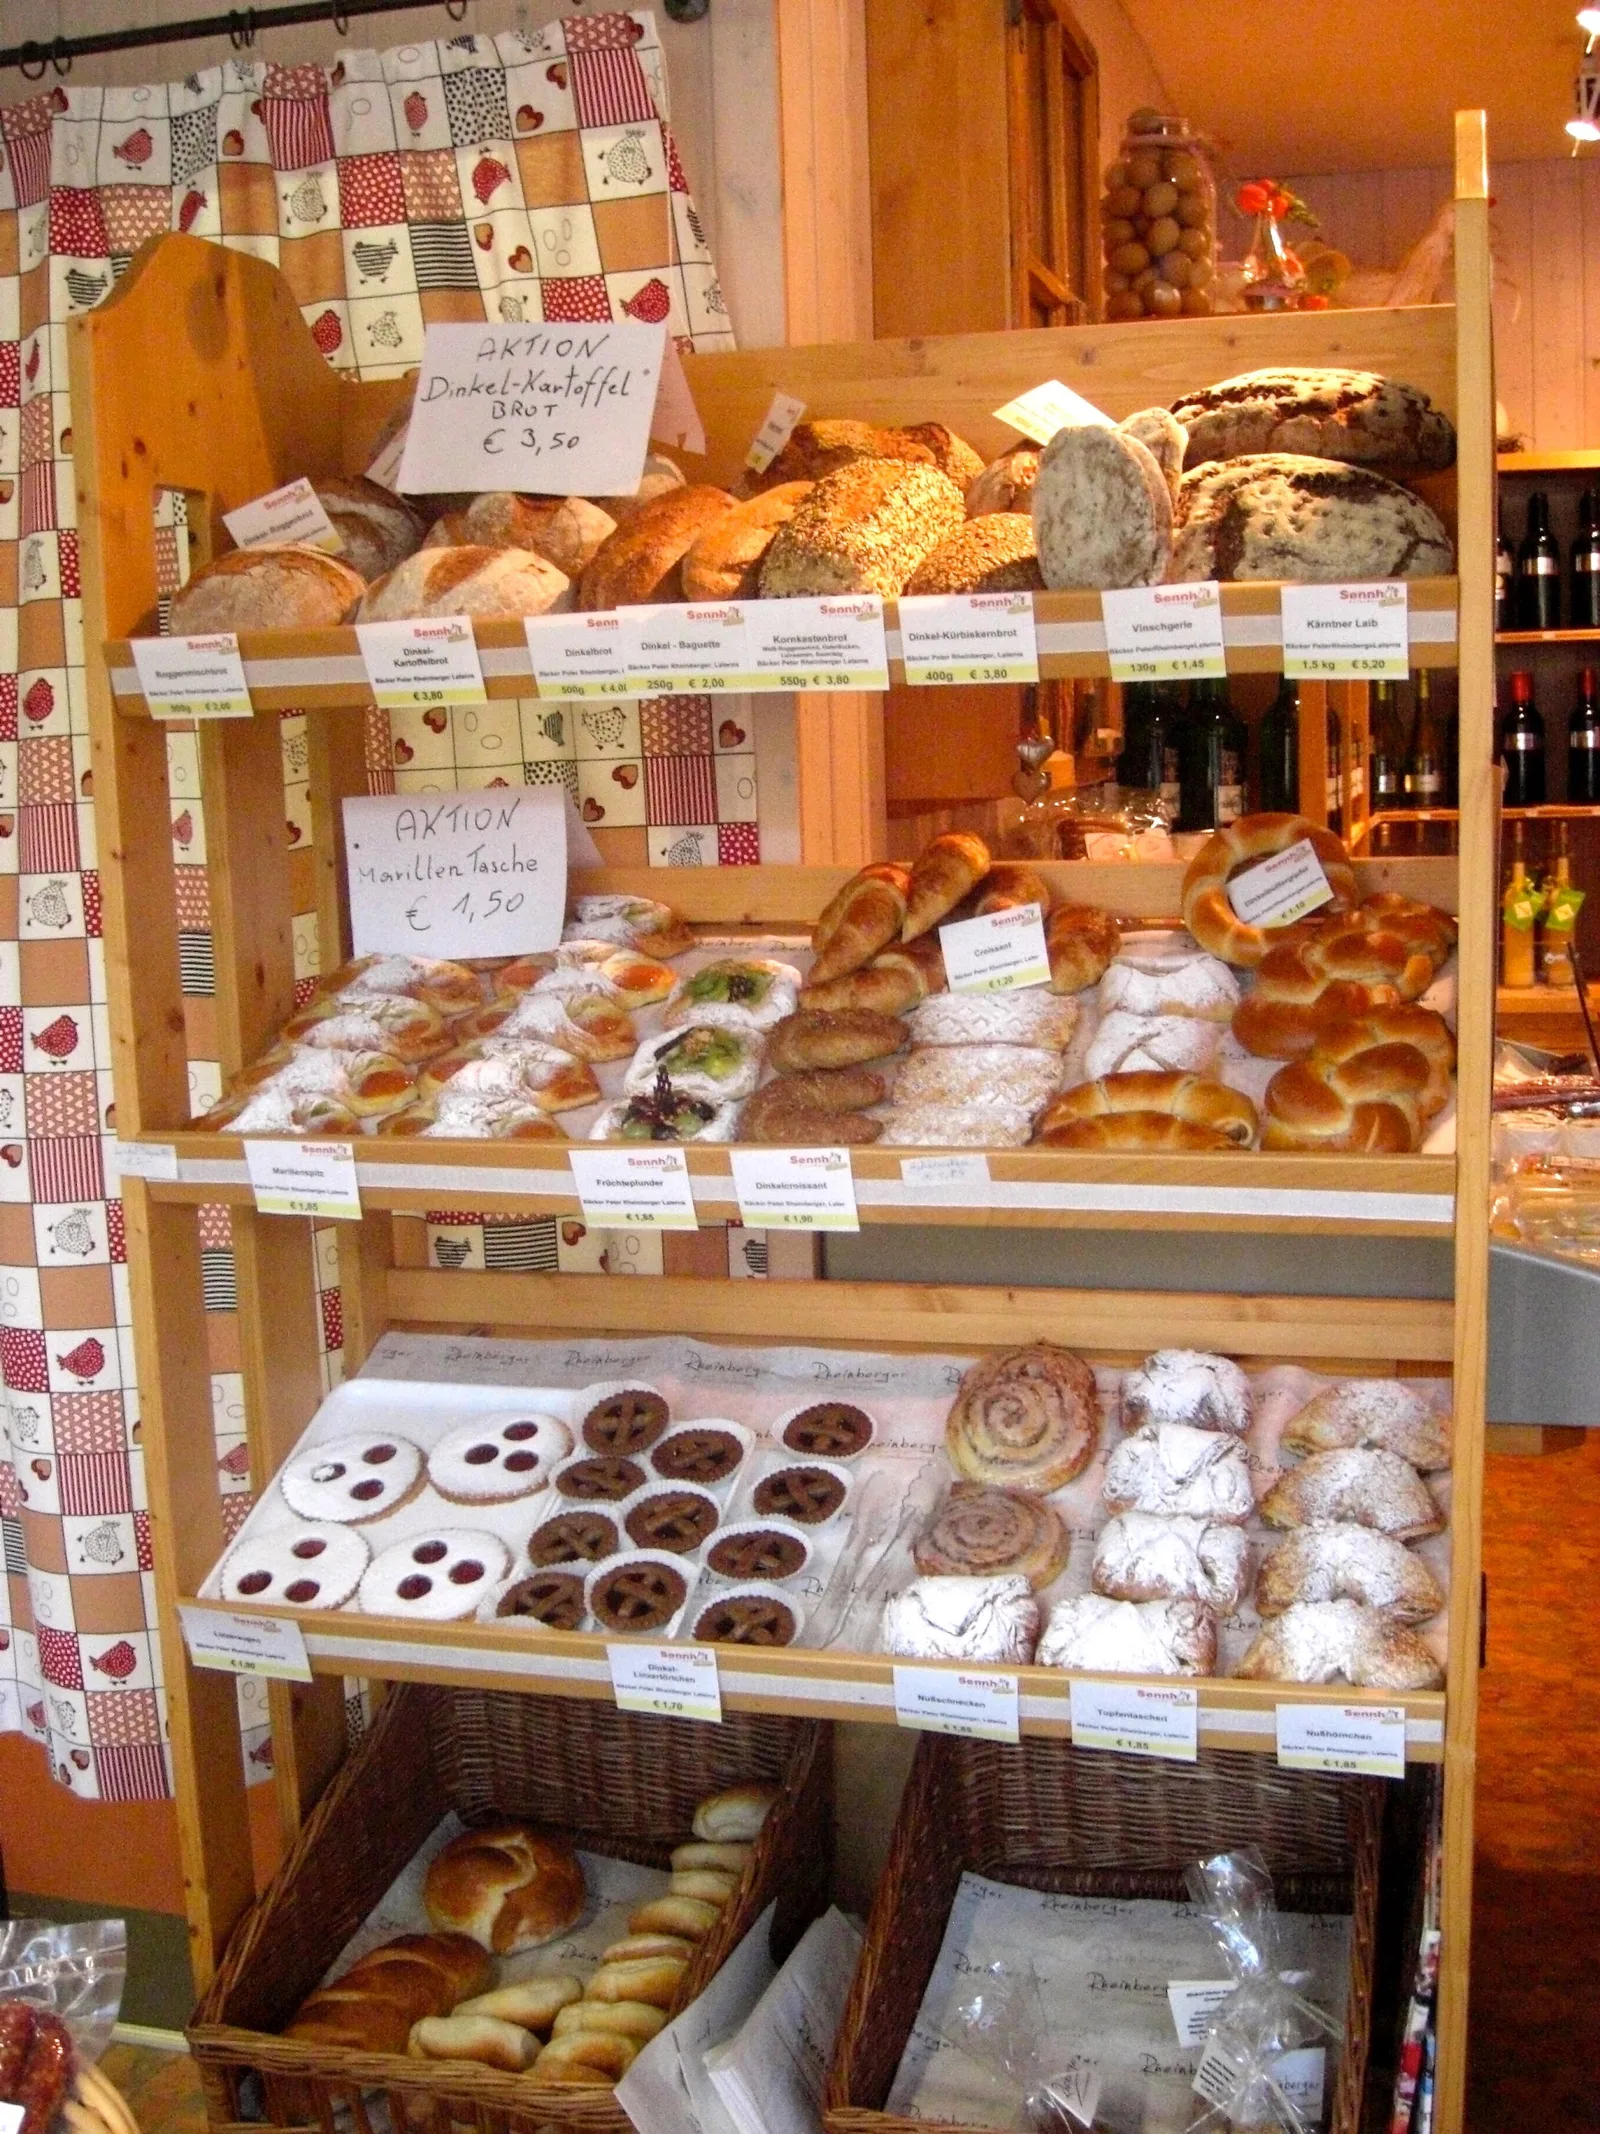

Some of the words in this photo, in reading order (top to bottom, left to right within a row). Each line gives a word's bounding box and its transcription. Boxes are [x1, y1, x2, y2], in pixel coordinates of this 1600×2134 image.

[477, 333, 610, 362] AKTION
[420, 364, 631, 407] Dinkel-Kartoffel
[492, 400, 559, 421] BROT
[483, 428, 505, 454] €
[521, 428, 580, 456] 3,50
[587, 618, 619, 628] Senn
[1132, 621, 1193, 632] Vinschgerle
[1307, 619, 1352, 628] Kärntner
[1355, 619, 1378, 628] Laib
[773, 634, 847, 643] Kornkastenbrot
[909, 629, 1017, 641] Dinkel-Kürbiskernbrot
[641, 642, 670, 651] Dinkel
[679, 640, 720, 650] Baguette
[403, 647, 434, 656] Dinkel-
[565, 648, 612, 657] Dinkelbrot
[393, 657, 448, 667] Kartoffelbrot
[1172, 661, 1178, 669] €
[1183, 659, 1204, 669] 1,45
[1302, 660, 1318, 669] 1,5
[1322, 660, 1335, 670] kg
[1352, 660, 1359, 669] €
[1361, 660, 1385, 669] 5,20
[926, 671, 954, 682] 400g
[970, 669, 977, 679] €
[983, 669, 1007, 680] 3,80
[647, 680, 673, 691] 250g
[689, 680, 695, 688] €
[702, 678, 724, 689] 2,00
[780, 676, 807, 687] 550g
[813, 675, 820, 685] €
[826, 675, 849, 686] 3,80
[561, 686, 585, 696] 500g
[601, 684, 607, 692] €
[413, 692, 420, 701] €
[422, 691, 443, 701] 3,80
[205, 702, 211, 711] €
[396, 798, 521, 842] AKTION
[358, 854, 463, 884] Marillen
[468, 843, 539, 874] Tasche
[405, 895, 431, 931] €
[452, 890, 524, 923] 1,50
[974, 941, 1012, 957] Croissant
[989, 980, 994, 989] €
[755, 1181, 828, 1190] Dinkelcroissant
[290, 1201, 296, 1209] €
[626, 1213, 632, 1221] €
[784, 1214, 790, 1222] €
[654, 1700, 659, 1708] €
[1116, 1739, 1122, 1747] €
